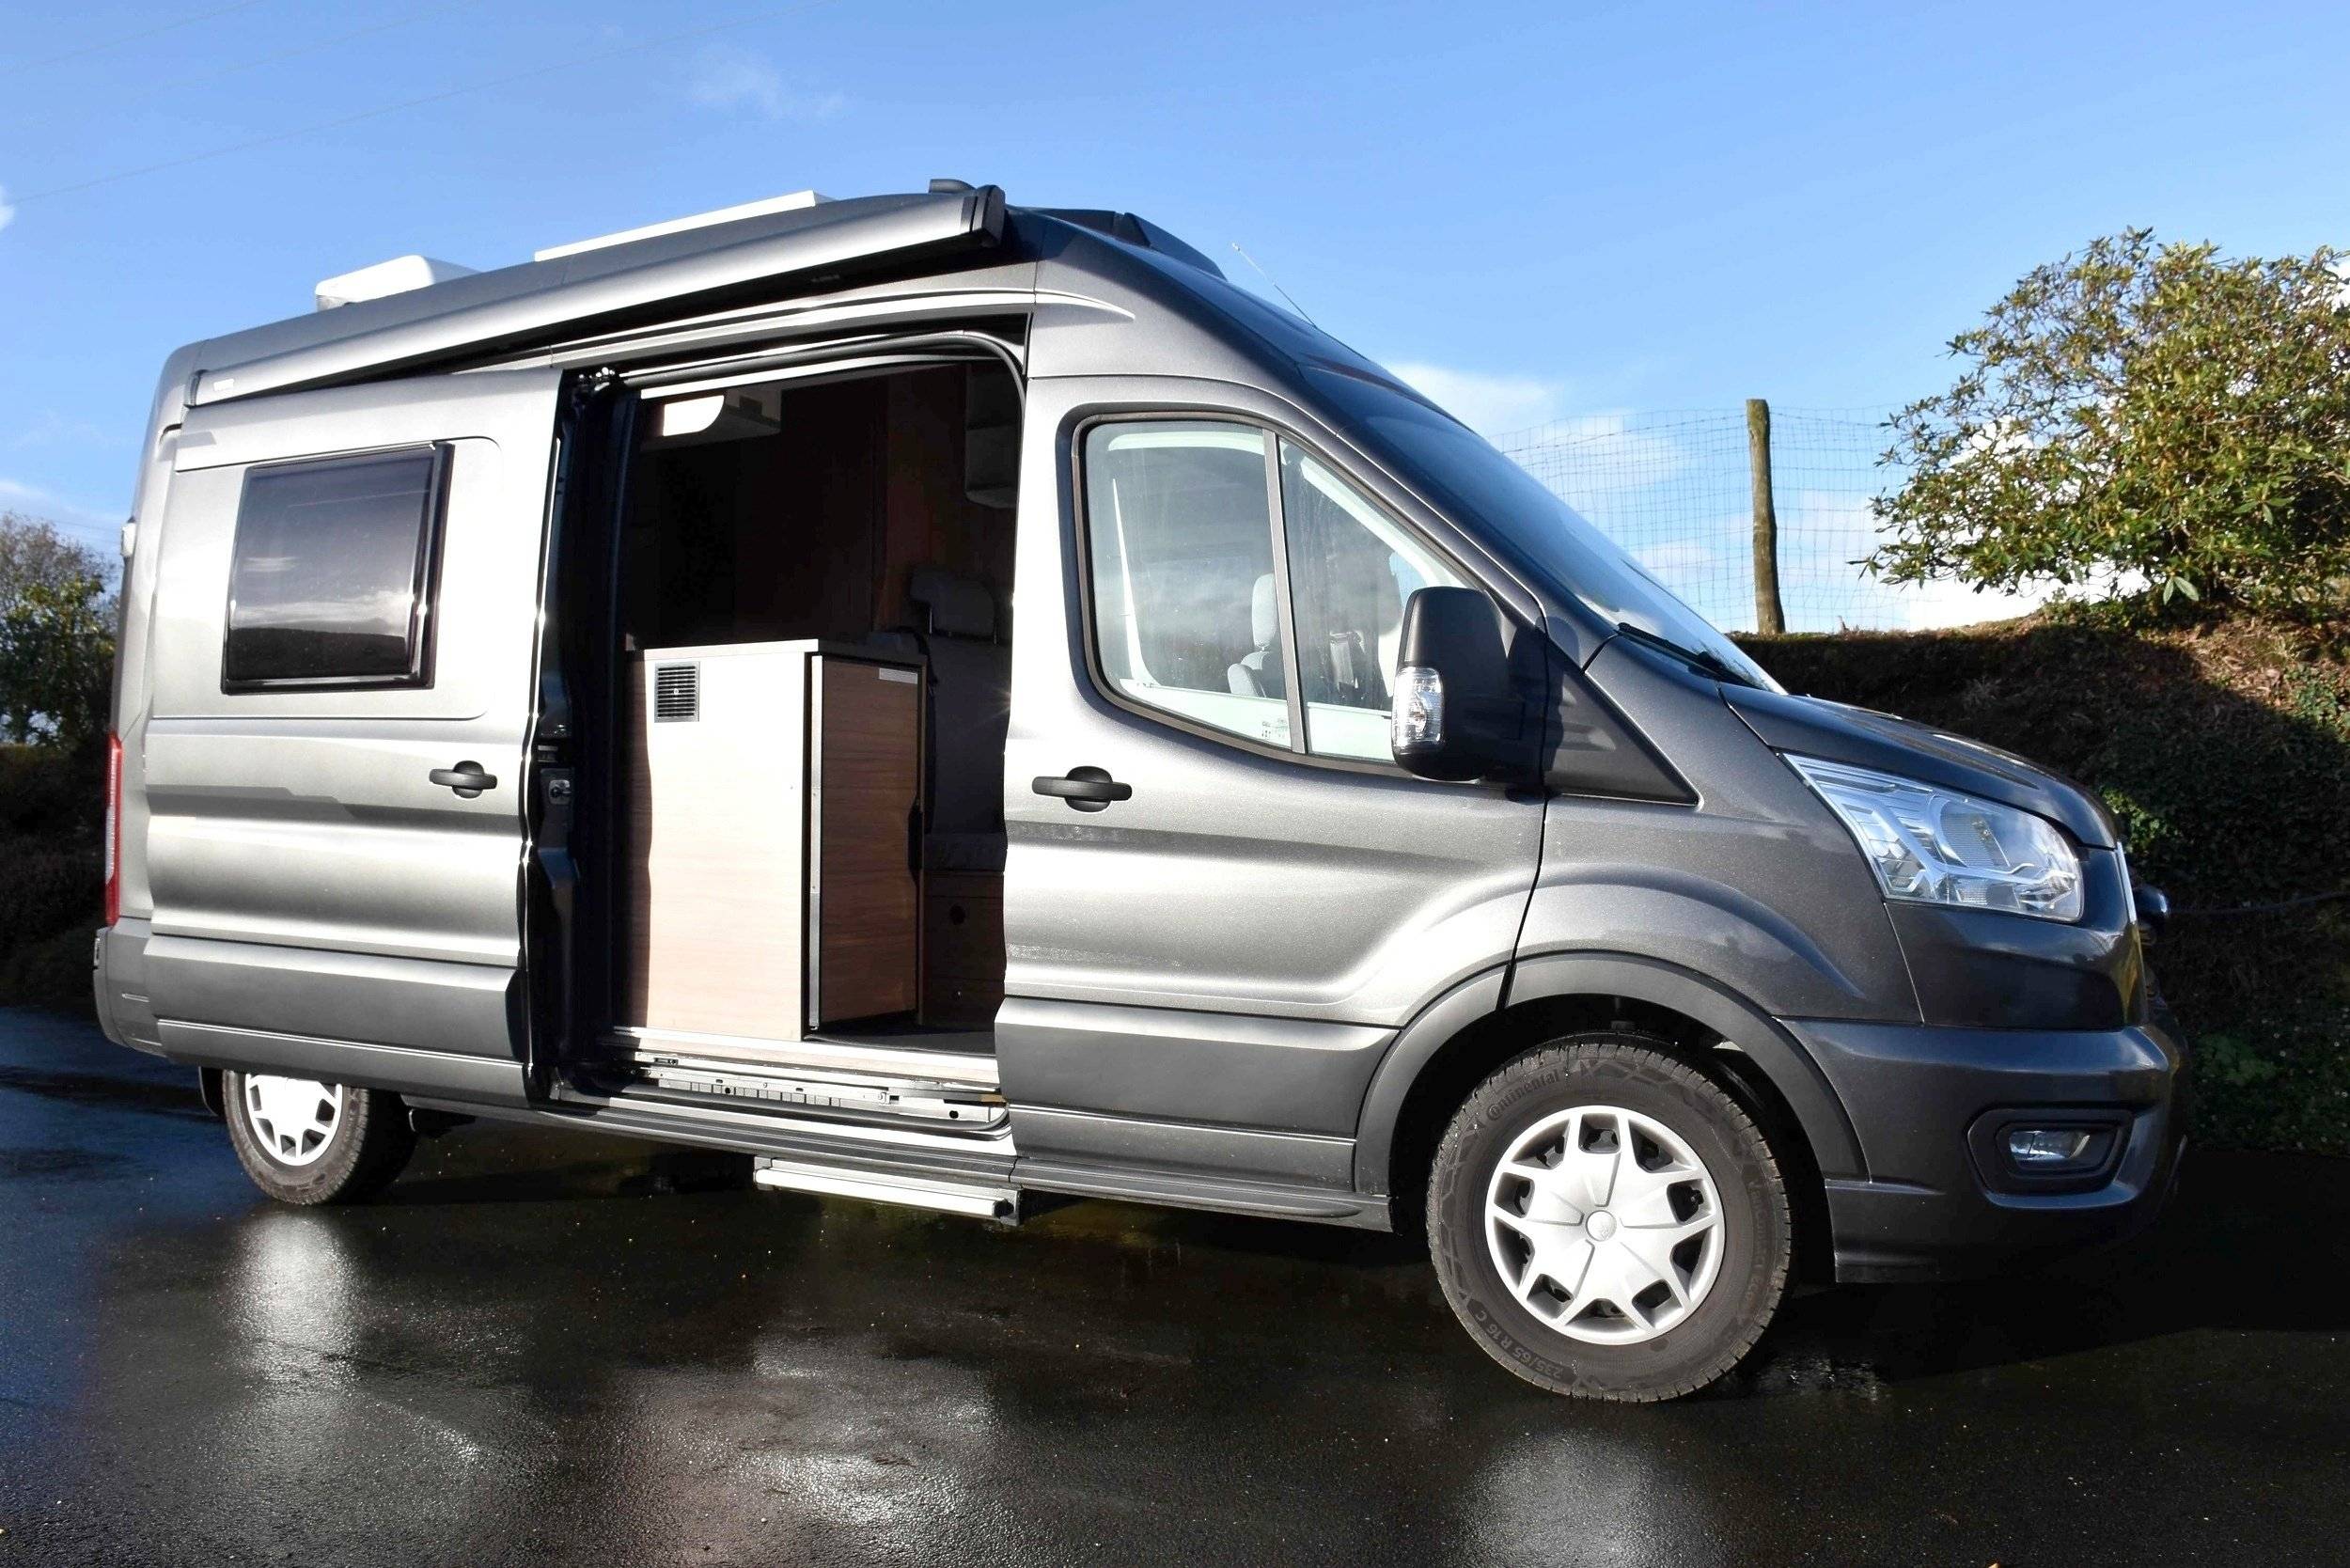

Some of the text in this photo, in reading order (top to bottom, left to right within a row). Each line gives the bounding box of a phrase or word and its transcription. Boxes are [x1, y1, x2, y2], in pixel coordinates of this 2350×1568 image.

[1486, 1069, 1560, 1121] Continental
[1475, 1309, 1488, 1322] C
[1513, 1347, 1564, 1379] 235/65
